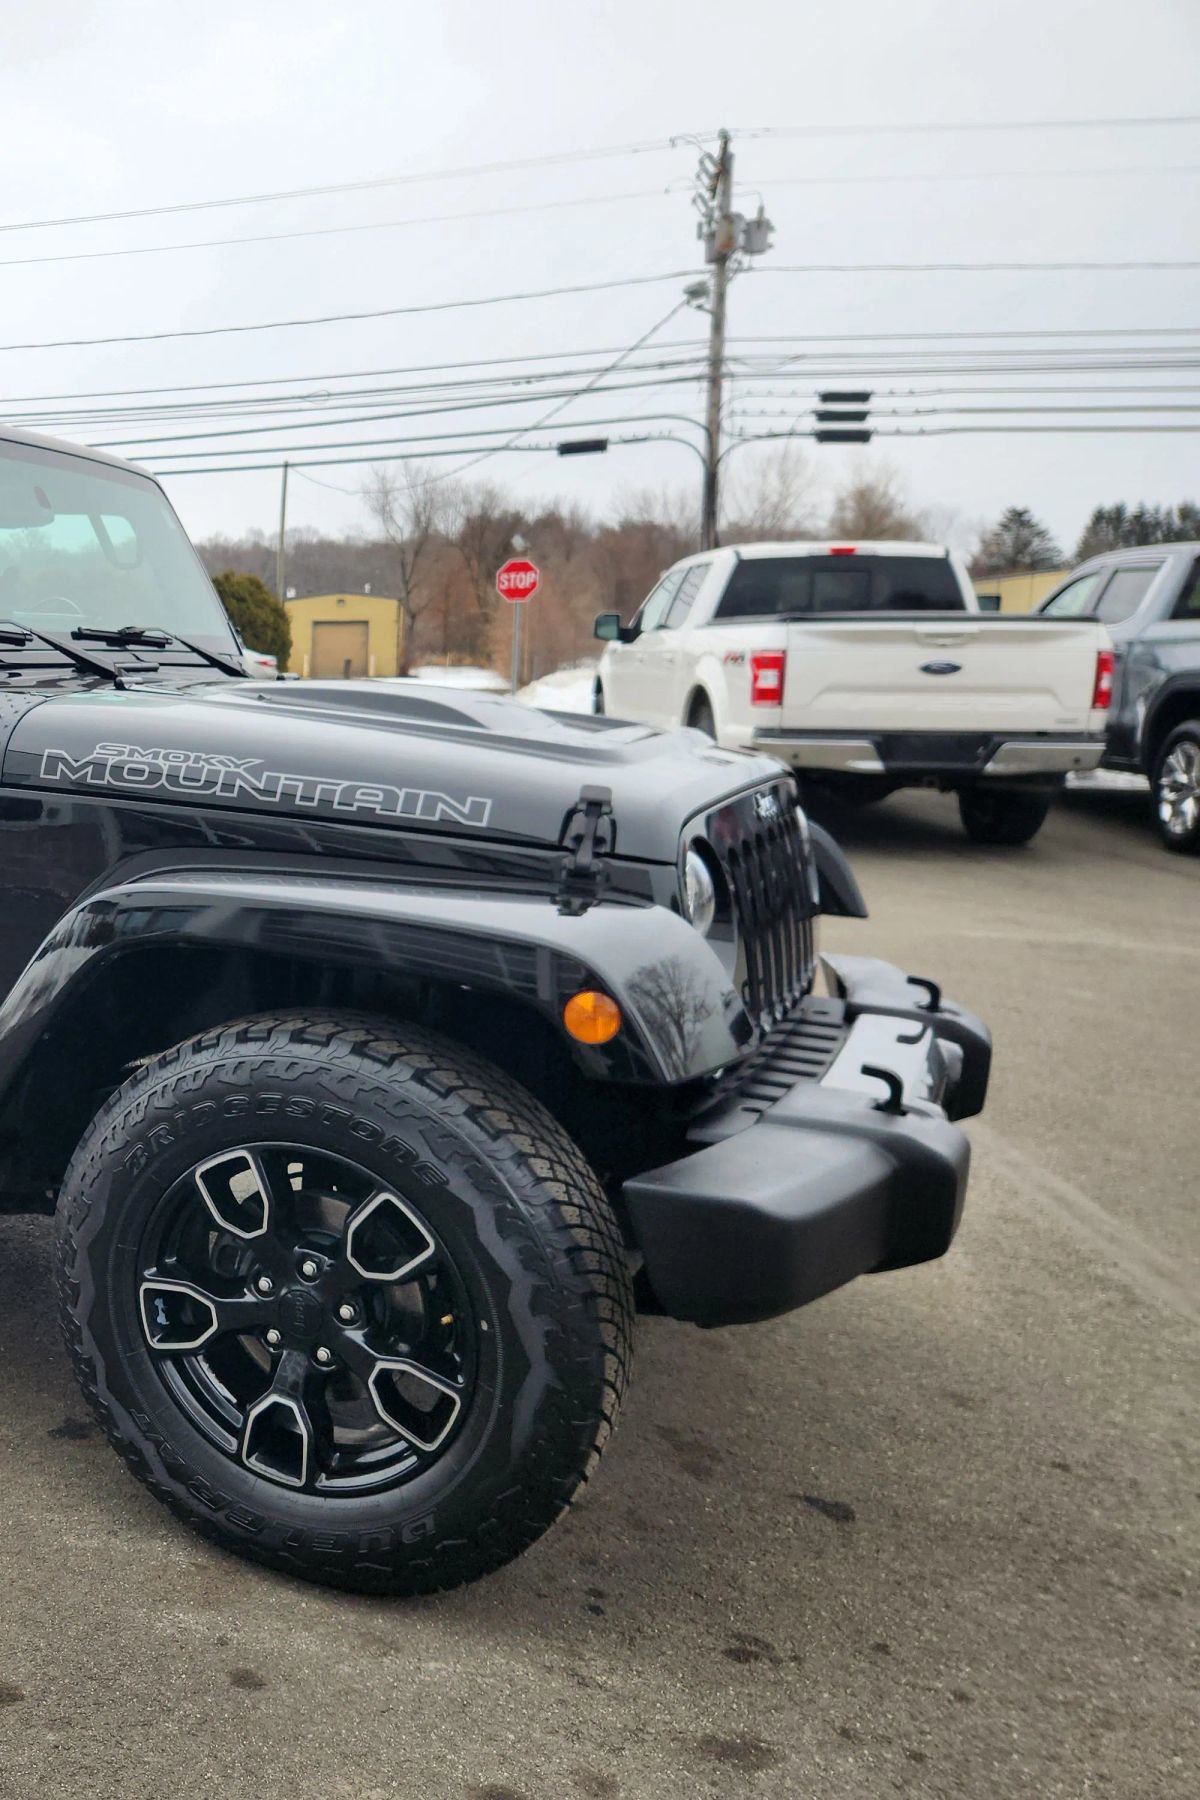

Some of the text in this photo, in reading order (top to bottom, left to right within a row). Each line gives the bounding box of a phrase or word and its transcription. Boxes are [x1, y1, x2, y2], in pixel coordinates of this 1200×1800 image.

[499, 570, 537, 591] STOP
[92, 742, 265, 771] SMOKY
[39, 748, 493, 828] MOUNTAIN
[122, 1091, 451, 1186] BRIDGESTONE
